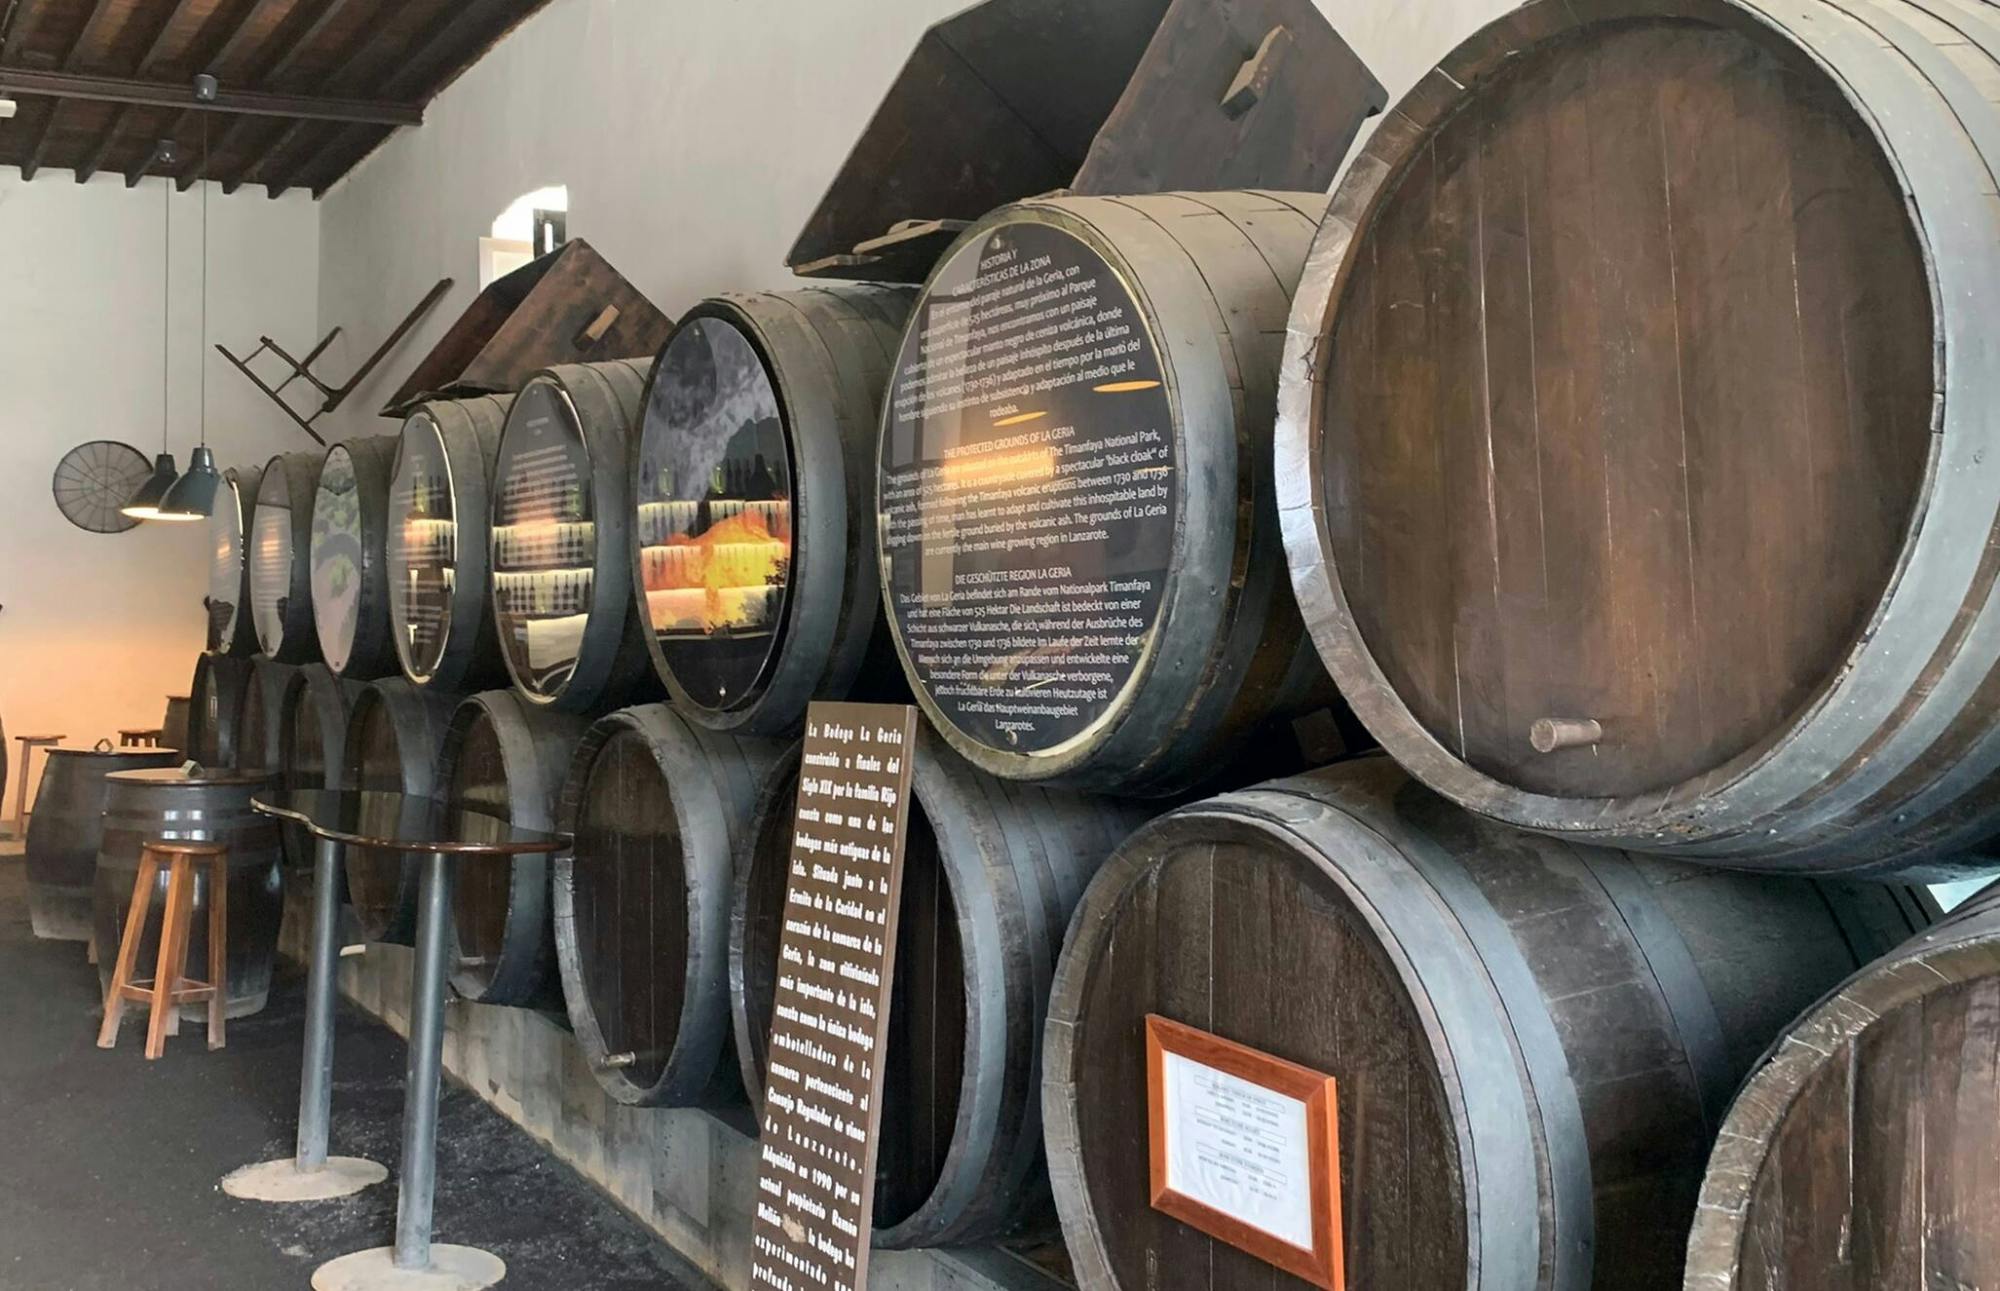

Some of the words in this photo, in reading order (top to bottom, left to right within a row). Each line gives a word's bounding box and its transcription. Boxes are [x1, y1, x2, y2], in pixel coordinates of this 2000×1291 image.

[1009, 266, 1019, 278] DE
[1020, 262, 1029, 275] LA
[1030, 255, 1051, 271] ZONA
[1066, 265, 1080, 278] con
[1061, 284, 1068, 297] al
[1070, 279, 1096, 295] Parque
[1045, 307, 1059, 319] con
[1060, 304, 1070, 315] un
[1071, 295, 1097, 315] paisaje
[1097, 307, 1122, 323] donde
[1053, 335, 1084, 353] después
[1085, 332, 1095, 344] de
[1096, 330, 1103, 342] la
[1105, 325, 1130, 339] última
[1045, 360, 1051, 372] el
[1053, 356, 1079, 370] tiempo
[1080, 352, 1093, 367] por
[1095, 349, 1102, 360] la
[1103, 345, 1126, 358] mano
[1127, 338, 1140, 353] del
[1077, 369, 1083, 382] al
[1085, 365, 1109, 380] medio
[1110, 363, 1126, 377] que
[1127, 359, 1135, 371] le
[994, 434, 1028, 450] GROUNDS
[1030, 432, 1040, 444] OF
[1041, 430, 1051, 442] LA
[1052, 426, 1075, 440] GERIA
[1050, 443, 1063, 456] The
[1064, 439, 1103, 454] Timanfaya
[1104, 432, 1138, 448] National
[1140, 429, 1160, 443] Park,
[1056, 465, 1060, 474] a
[1062, 457, 1104, 476] spectacular
[1159, 446, 1168, 458] of
[1077, 476, 1112, 489] between
[1114, 473, 1130, 487] 1730
[1132, 468, 1148, 482] and
[1150, 466, 1168, 482] 1736
[1027, 500, 1040, 512] and
[1073, 495, 1087, 507] this
[1088, 488, 1136, 505] inhospitable
[1138, 486, 1156, 499] land
[1157, 485, 1168, 499] by
[1074, 512, 1088, 524] The
[1089, 508, 1122, 525] grounds
[1123, 506, 1132, 519] of
[1134, 507, 1143, 518] La
[1145, 504, 1167, 516] Geria
[1036, 533, 1059, 548] region
[1060, 532, 1067, 543] in
[1069, 529, 1109, 543] Lanzarote.
[1009, 569, 1036, 581] REGION
[1038, 568, 1047, 579] LA
[1048, 567, 1072, 579] GERIA
[1060, 581, 1108, 596] Nationalpark
[1110, 579, 1150, 593] Timanfaya
[1022, 600, 1060, 613] Landschaft
[1062, 601, 1070, 612] ist
[1072, 599, 1102, 611] bedeckt
[1104, 601, 1119, 610] von
[1120, 598, 1141, 609] einer
[1071, 617, 1084, 629] der
[1085, 616, 1127, 629] Ausbrüche
[1128, 616, 1143, 628] des
[1070, 635, 1083, 647] der
[1084, 635, 1099, 646] Zeit
[1100, 635, 1123, 646] lernte
[1125, 634, 1138, 646] der
[1051, 652, 1065, 664] und
[1112, 653, 1129, 664] eine
[1053, 687, 1096, 701] Heutzutage
[1098, 688, 1107, 699] ist
[808, 722, 817, 737] La
[824, 723, 854, 744] Bodega
[860, 726, 870, 742] La
[877, 728, 902, 744] Geria
[887, 758, 900, 774] del
[832, 785, 844, 801] por
[845, 783, 852, 798] la
[867, 815, 876, 831] de
[882, 817, 893, 833] las
[871, 846, 881, 862] de
[883, 848, 891, 864] la
[868, 880, 874, 892] a
[880, 878, 888, 895] la
[814, 893, 823, 910] de
[825, 896, 832, 912] la
[835, 899, 863, 920] Caridad
[865, 909, 874, 922] en
[877, 910, 885, 925] el
[812, 922, 822, 939] de
[823, 925, 830, 941] la
[863, 936, 872, 953] de
[874, 939, 882, 956] la
[807, 950, 814, 967] la
[837, 990, 846, 1008] de
[849, 994, 856, 1011] la
[818, 1015, 826, 1032] la
[848, 1025, 873, 1052] bodega
[774, 1033, 836, 1067] embotelladora
[843, 1056, 854, 1074] de
[861, 1062, 871, 1080] la
[860, 1096, 868, 1112] al
[796, 1098, 832, 1128] Regulador
[834, 1115, 843, 1133] de
[765, 1115, 778, 1135] de
[788, 1126, 862, 1175] Lanzarote.
[762, 1143, 795, 1174] Adquirida
[812, 1168, 832, 1192] 1990
[835, 1183, 848, 1201] por
[808, 1229, 815, 1248] la
[818, 1235, 842, 1266] bodega
[755, 1234, 827, 1285] experimentado
